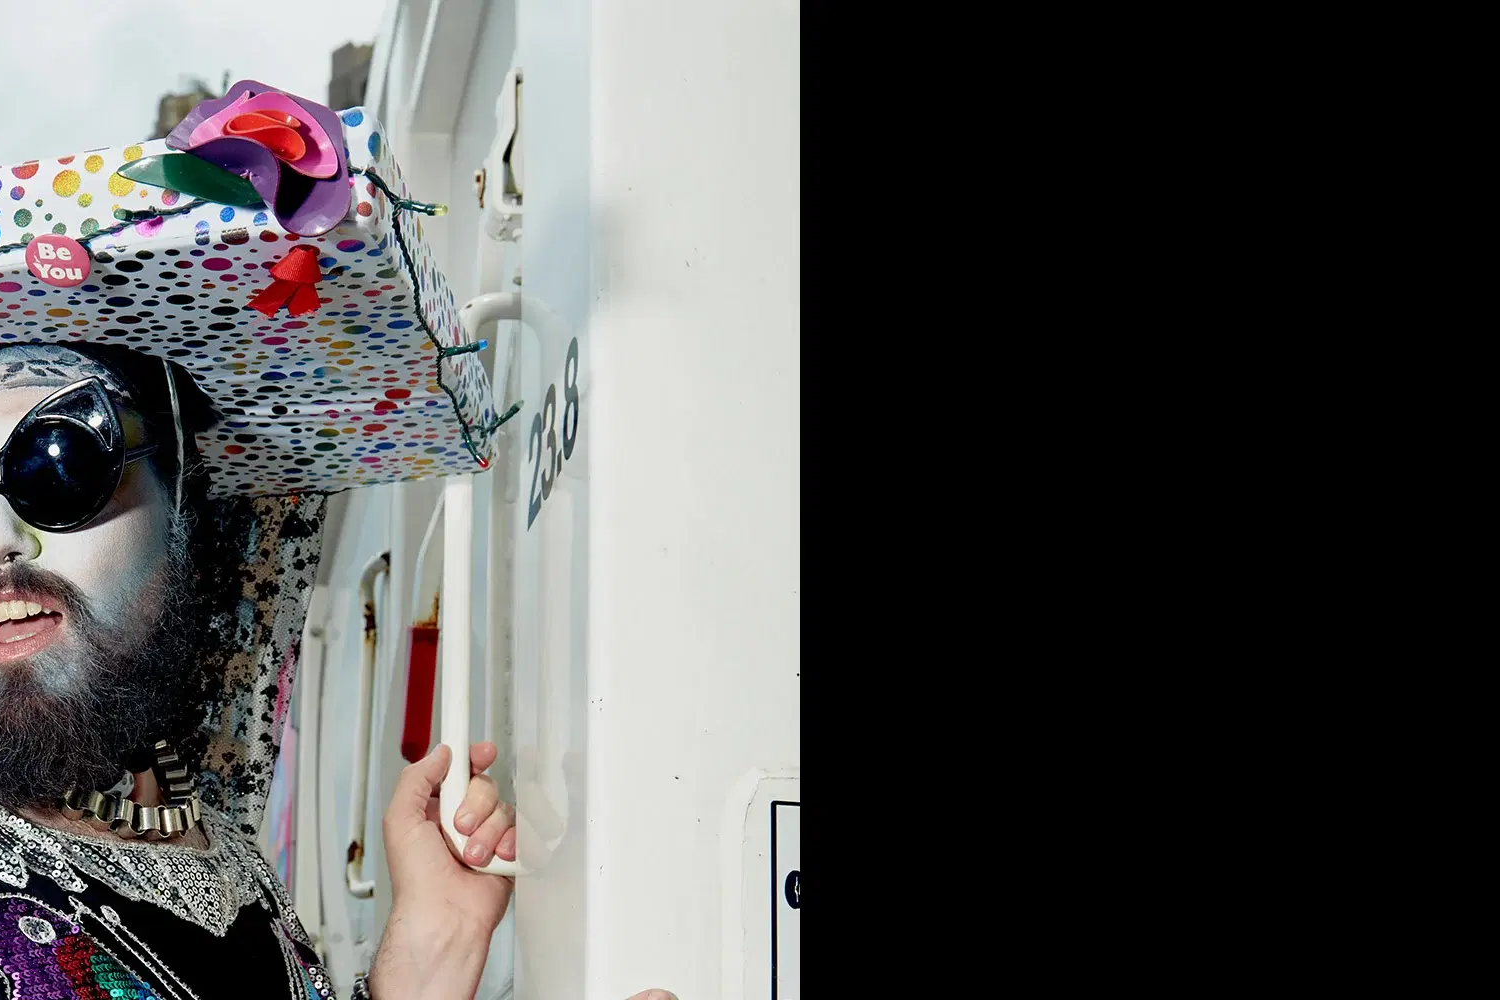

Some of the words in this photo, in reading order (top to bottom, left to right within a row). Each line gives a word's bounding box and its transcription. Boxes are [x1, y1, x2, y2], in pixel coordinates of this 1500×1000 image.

[37, 242, 72, 261] Be
[33, 263, 83, 280] You
[527, 336, 579, 532] 23.8
